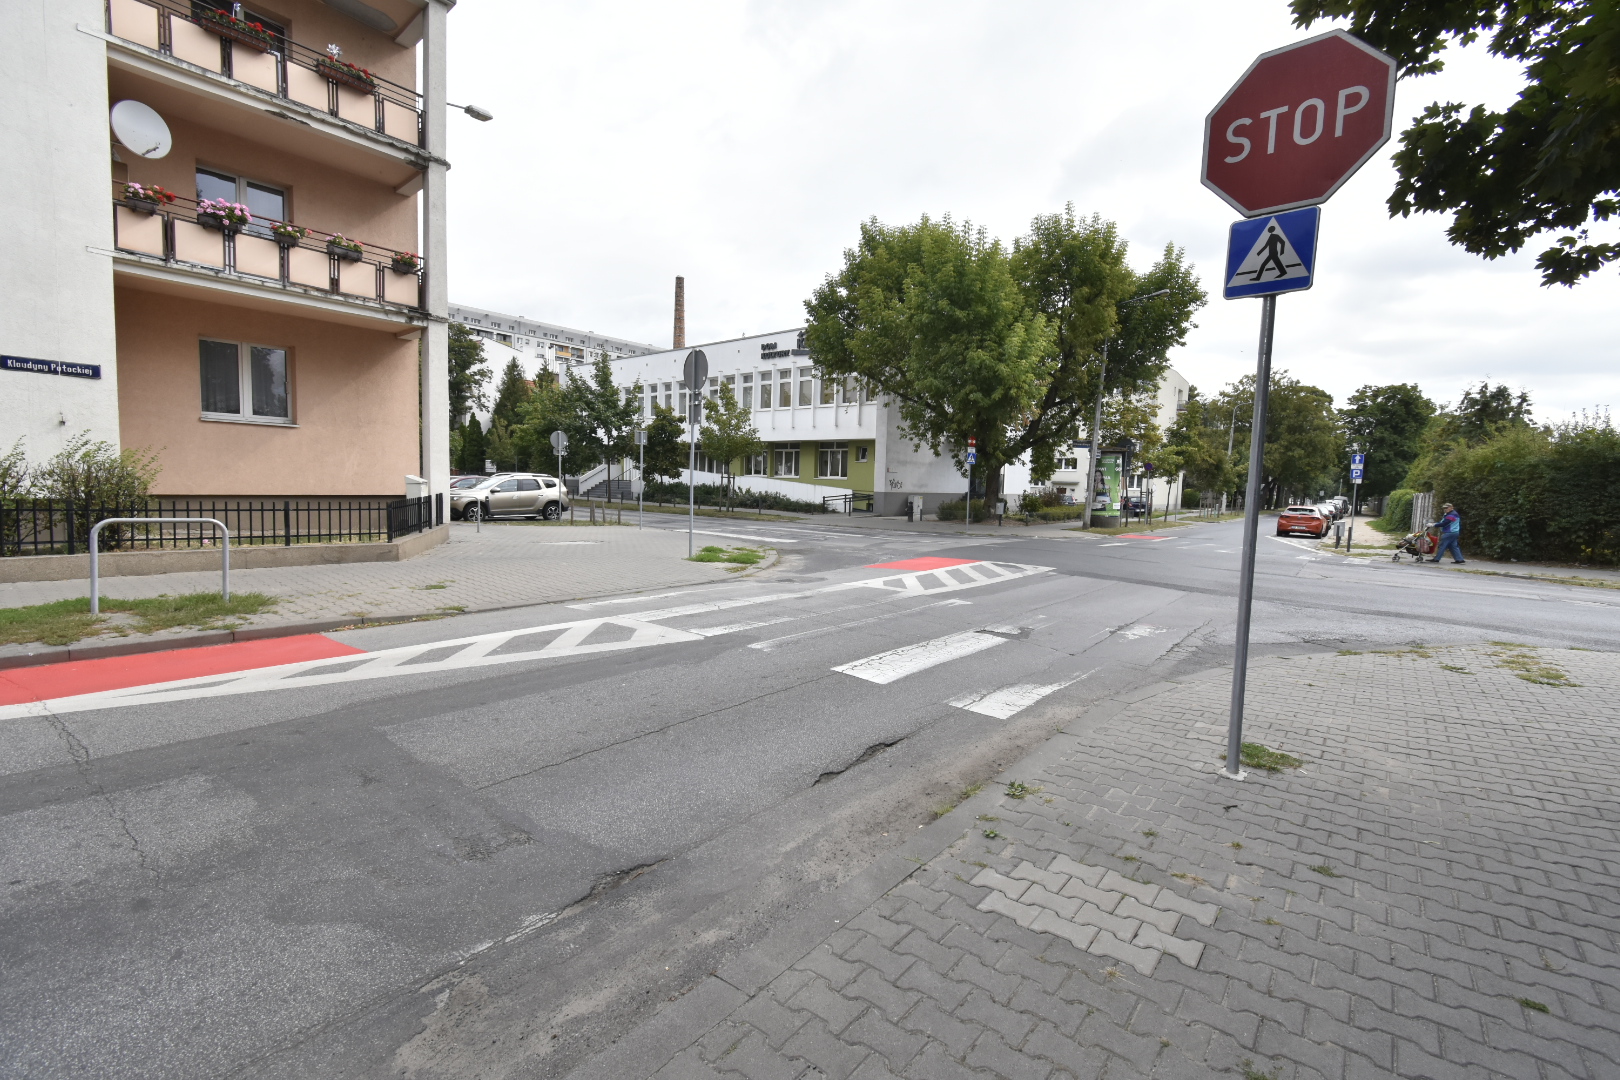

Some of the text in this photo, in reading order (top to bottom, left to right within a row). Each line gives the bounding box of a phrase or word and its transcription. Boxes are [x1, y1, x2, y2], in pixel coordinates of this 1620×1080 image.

[1224, 85, 1370, 164] STOP
[761, 342, 778, 351] DOM
[7, 359, 92, 376] Klaudyny Potockiej
[1352, 469, 1361, 478] P
